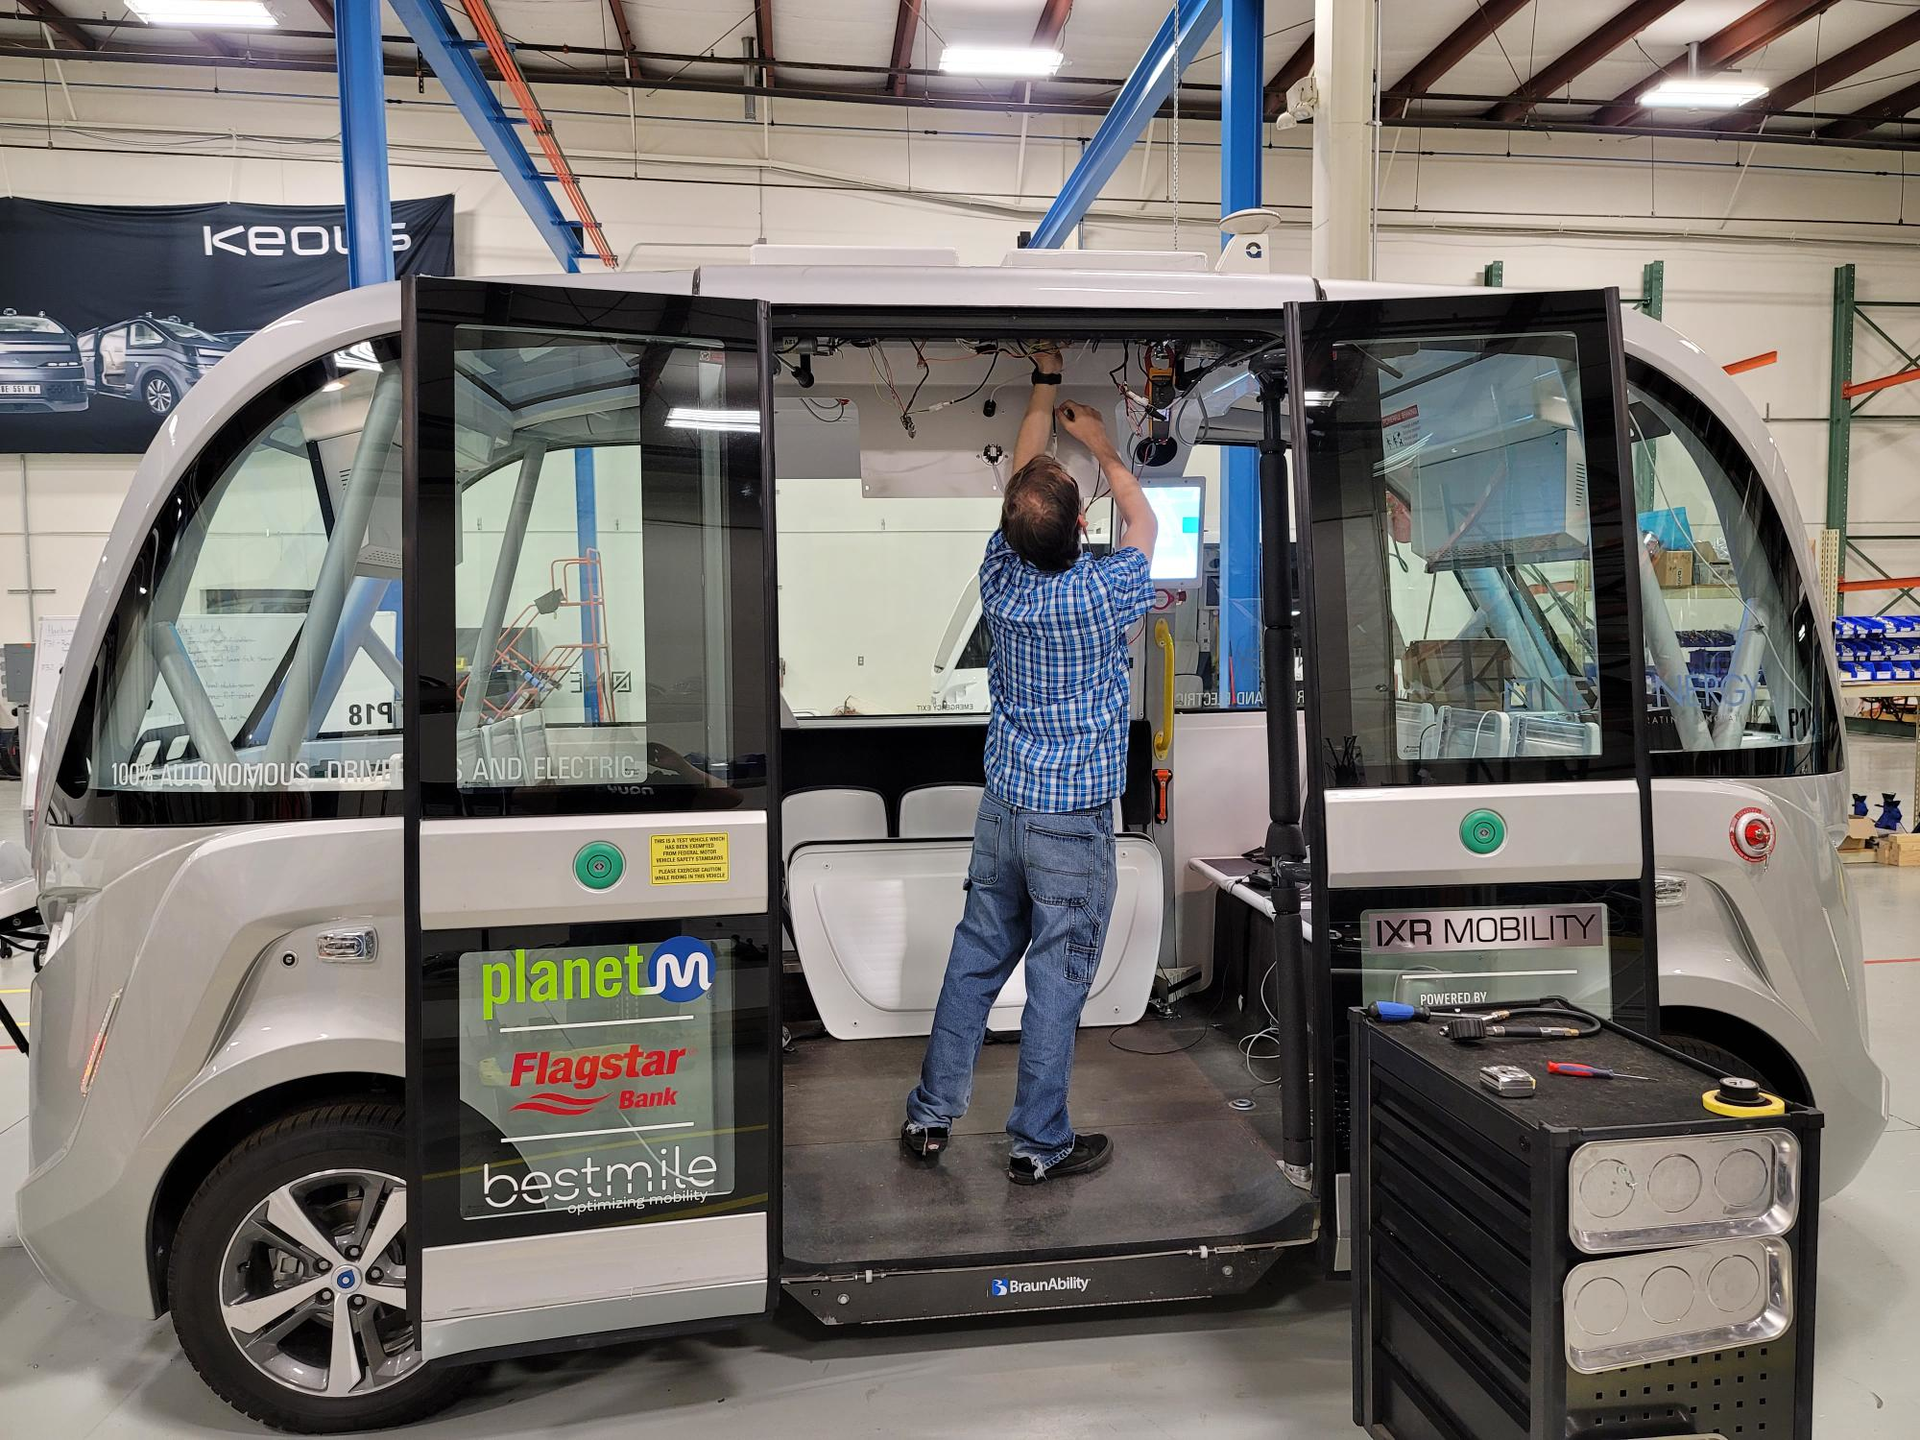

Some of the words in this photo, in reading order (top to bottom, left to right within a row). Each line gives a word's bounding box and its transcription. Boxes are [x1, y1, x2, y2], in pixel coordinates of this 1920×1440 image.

[1655, 674, 1761, 707] NERGY
[111, 762, 153, 786] 100%
[472, 756, 523, 781] AND
[533, 755, 636, 780] ELECTRIC
[1376, 918, 1433, 947] IXR
[1444, 914, 1596, 944] MOBILITY
[1420, 992, 1471, 1005] POWERED
[1473, 991, 1487, 1003] BY
[510, 1044, 687, 1090] Flagstar
[618, 1086, 679, 1110] Bank
[483, 1145, 717, 1208] bestmile
[567, 1193, 646, 1215] optimizing
[649, 1189, 709, 1204] mobility
[1009, 1276, 1089, 1293] BraunAbility
